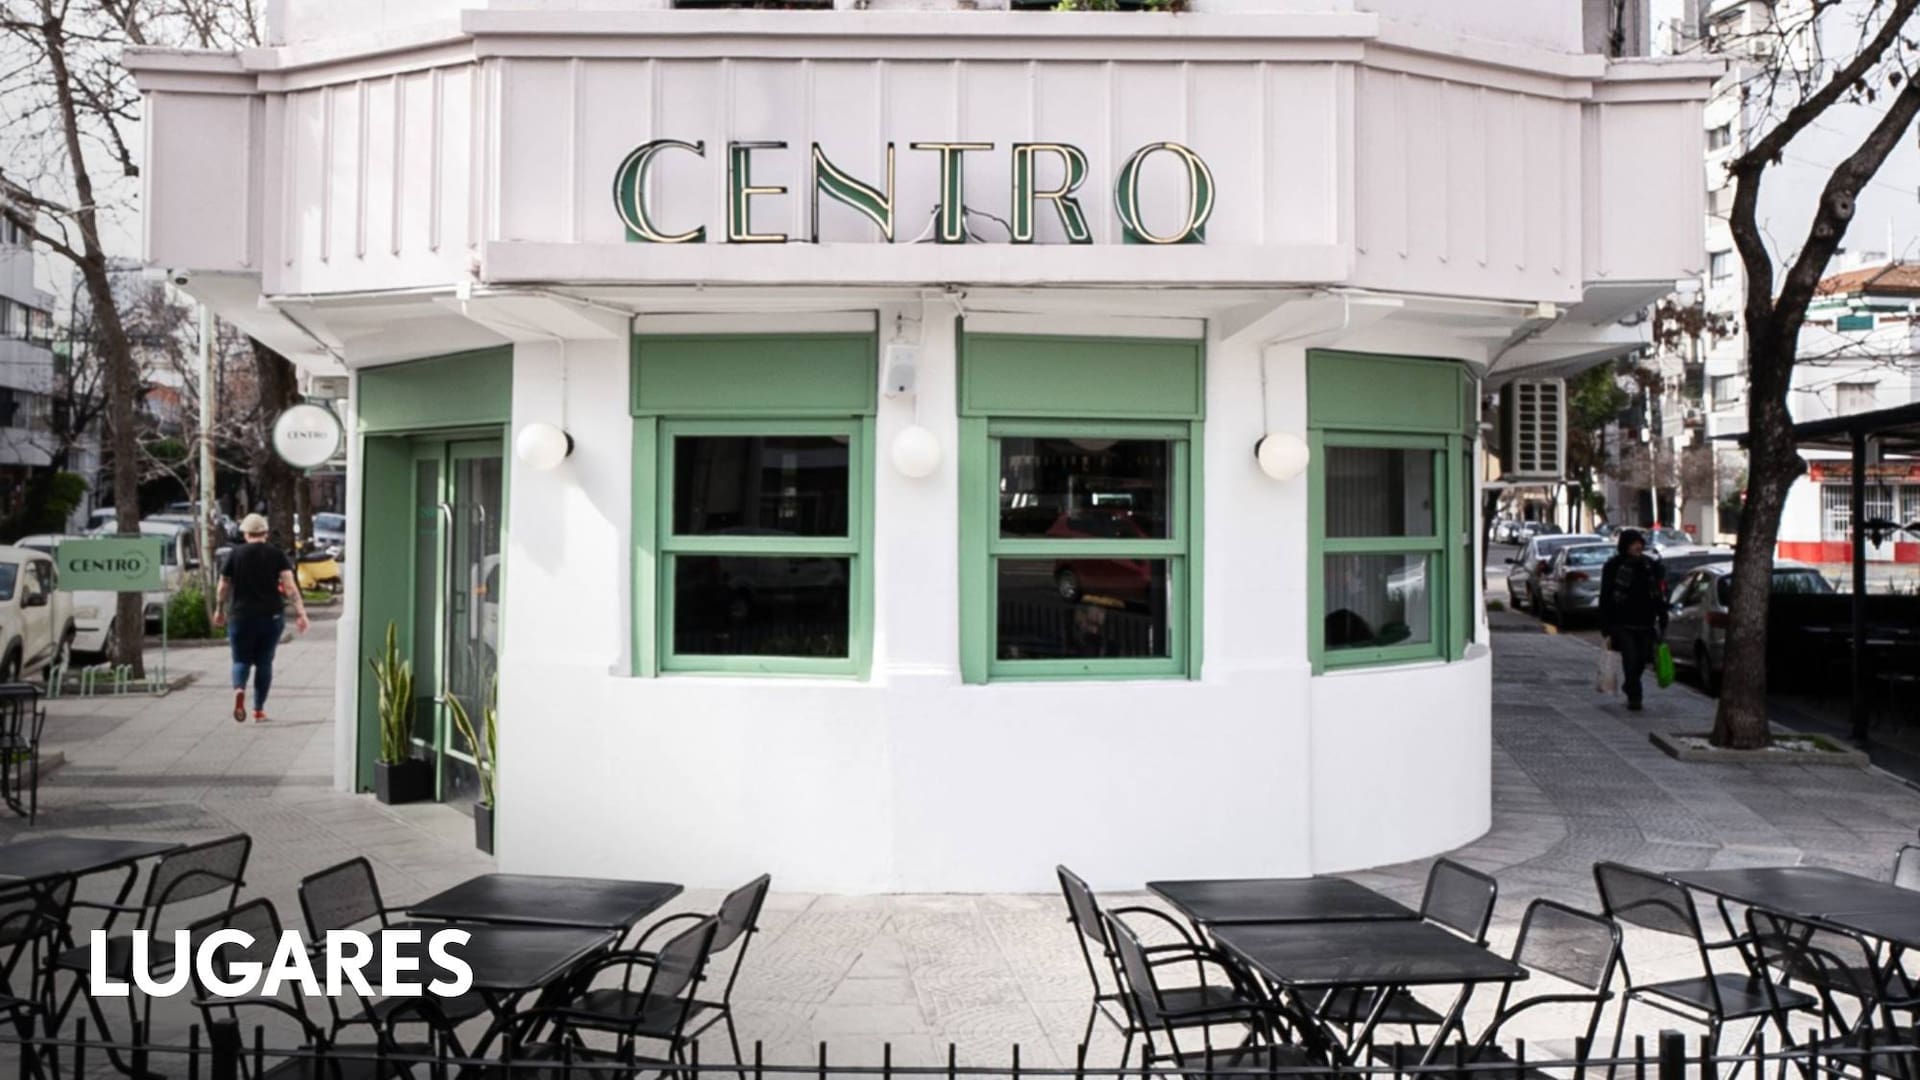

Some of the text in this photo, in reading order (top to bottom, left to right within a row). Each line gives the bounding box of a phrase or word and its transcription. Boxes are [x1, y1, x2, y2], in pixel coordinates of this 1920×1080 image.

[612, 139, 1216, 244] CENTRO
[287, 431, 328, 440] CENTRO
[69, 559, 141, 573] CENTRO
